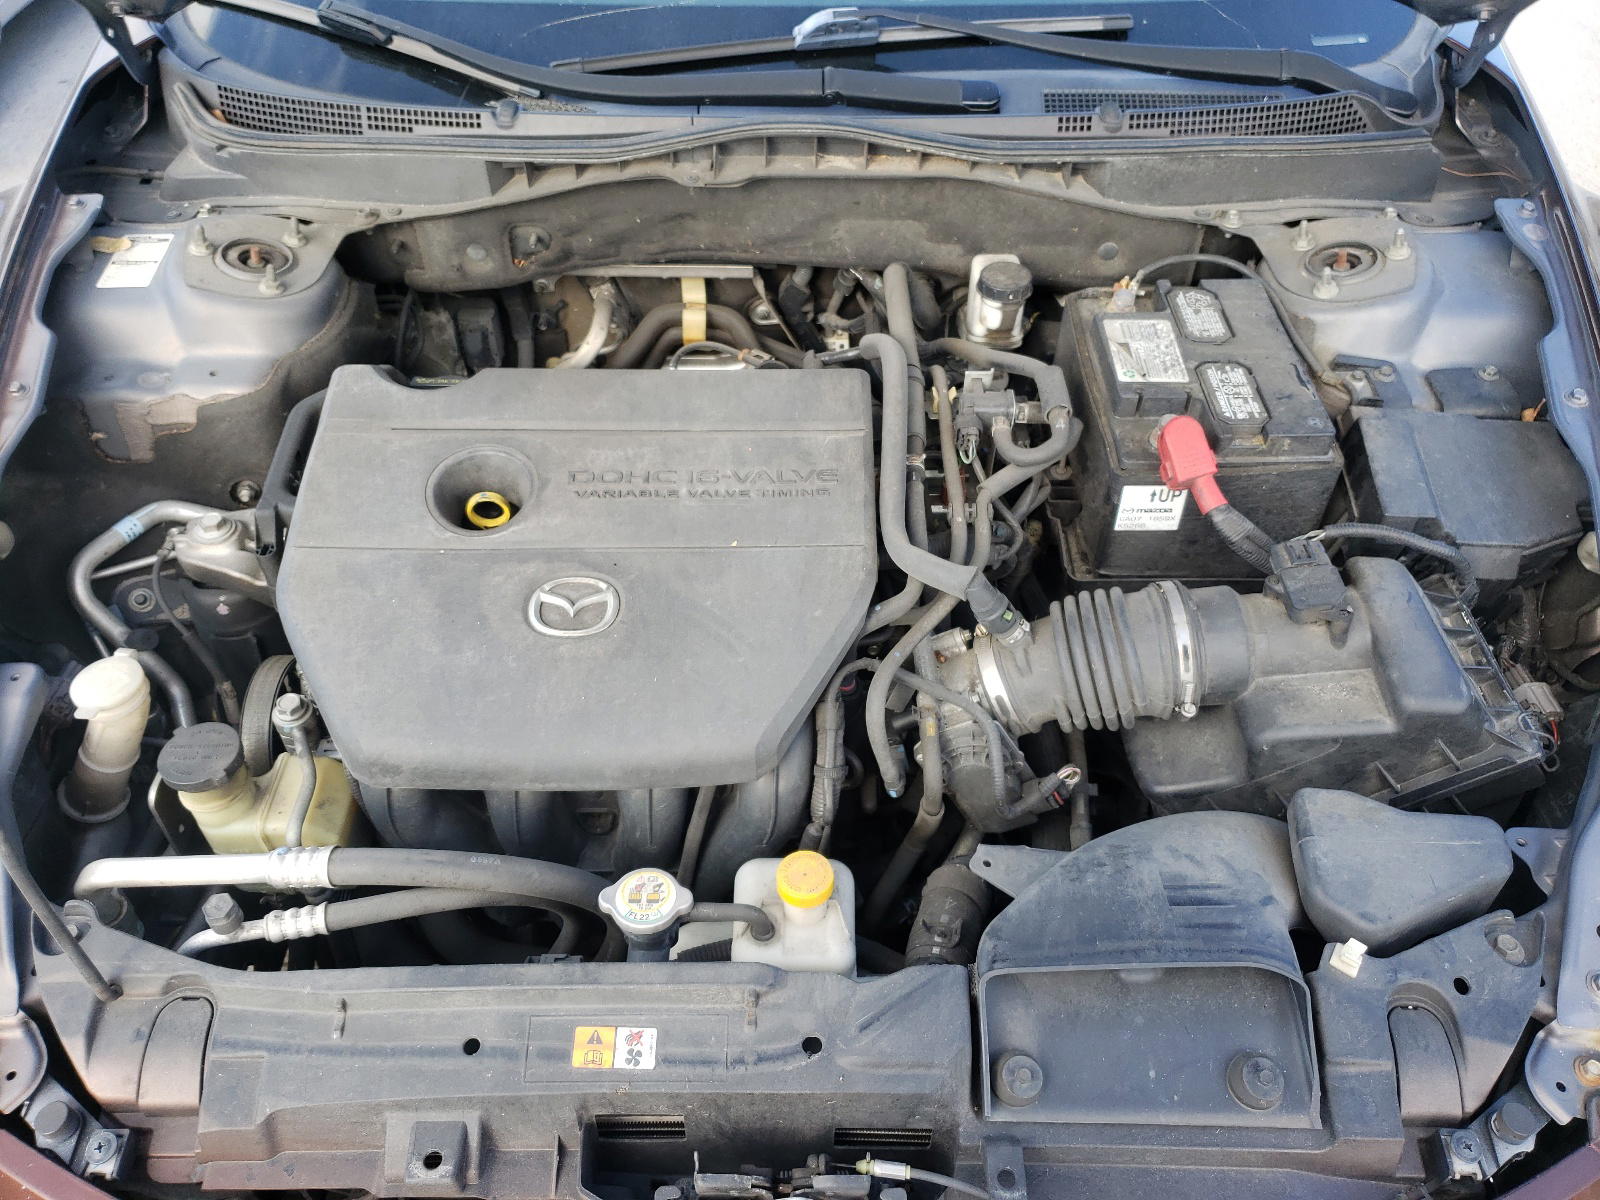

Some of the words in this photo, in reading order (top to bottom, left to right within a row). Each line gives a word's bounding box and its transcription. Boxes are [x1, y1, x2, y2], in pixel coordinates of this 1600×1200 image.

[568, 470, 678, 484] DOHC
[687, 469, 839, 485] 16-VALVE
[574, 489, 680, 499] VARIABLE
[687, 488, 751, 499] VALVE
[757, 487, 832, 499] TIMING
[1158, 488, 1183, 503] UP
[628, 911, 650, 921] FL22
